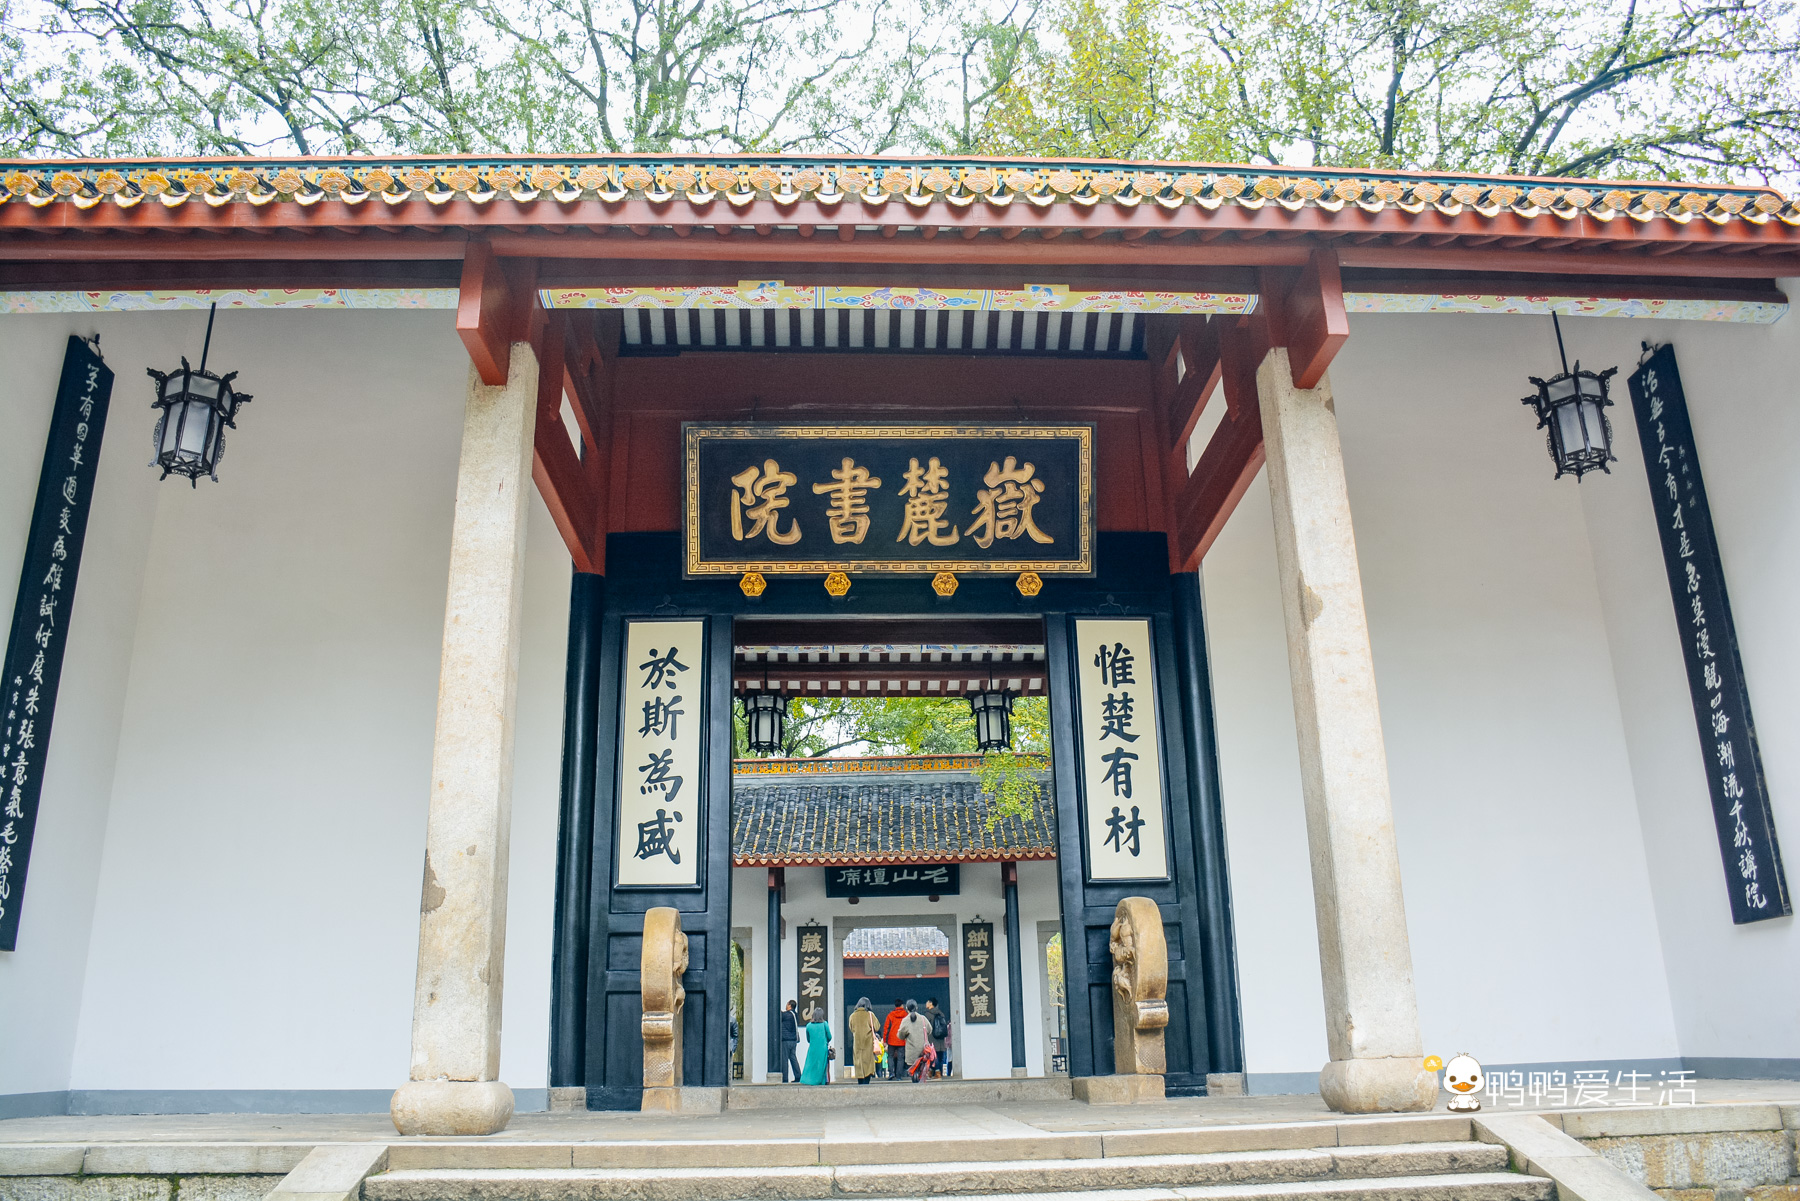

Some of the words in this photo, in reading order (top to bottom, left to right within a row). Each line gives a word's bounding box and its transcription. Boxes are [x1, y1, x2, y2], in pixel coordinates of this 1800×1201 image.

[633, 646, 690, 865] 於斯為盛
[1093, 642, 1146, 857] 惟楚有材
